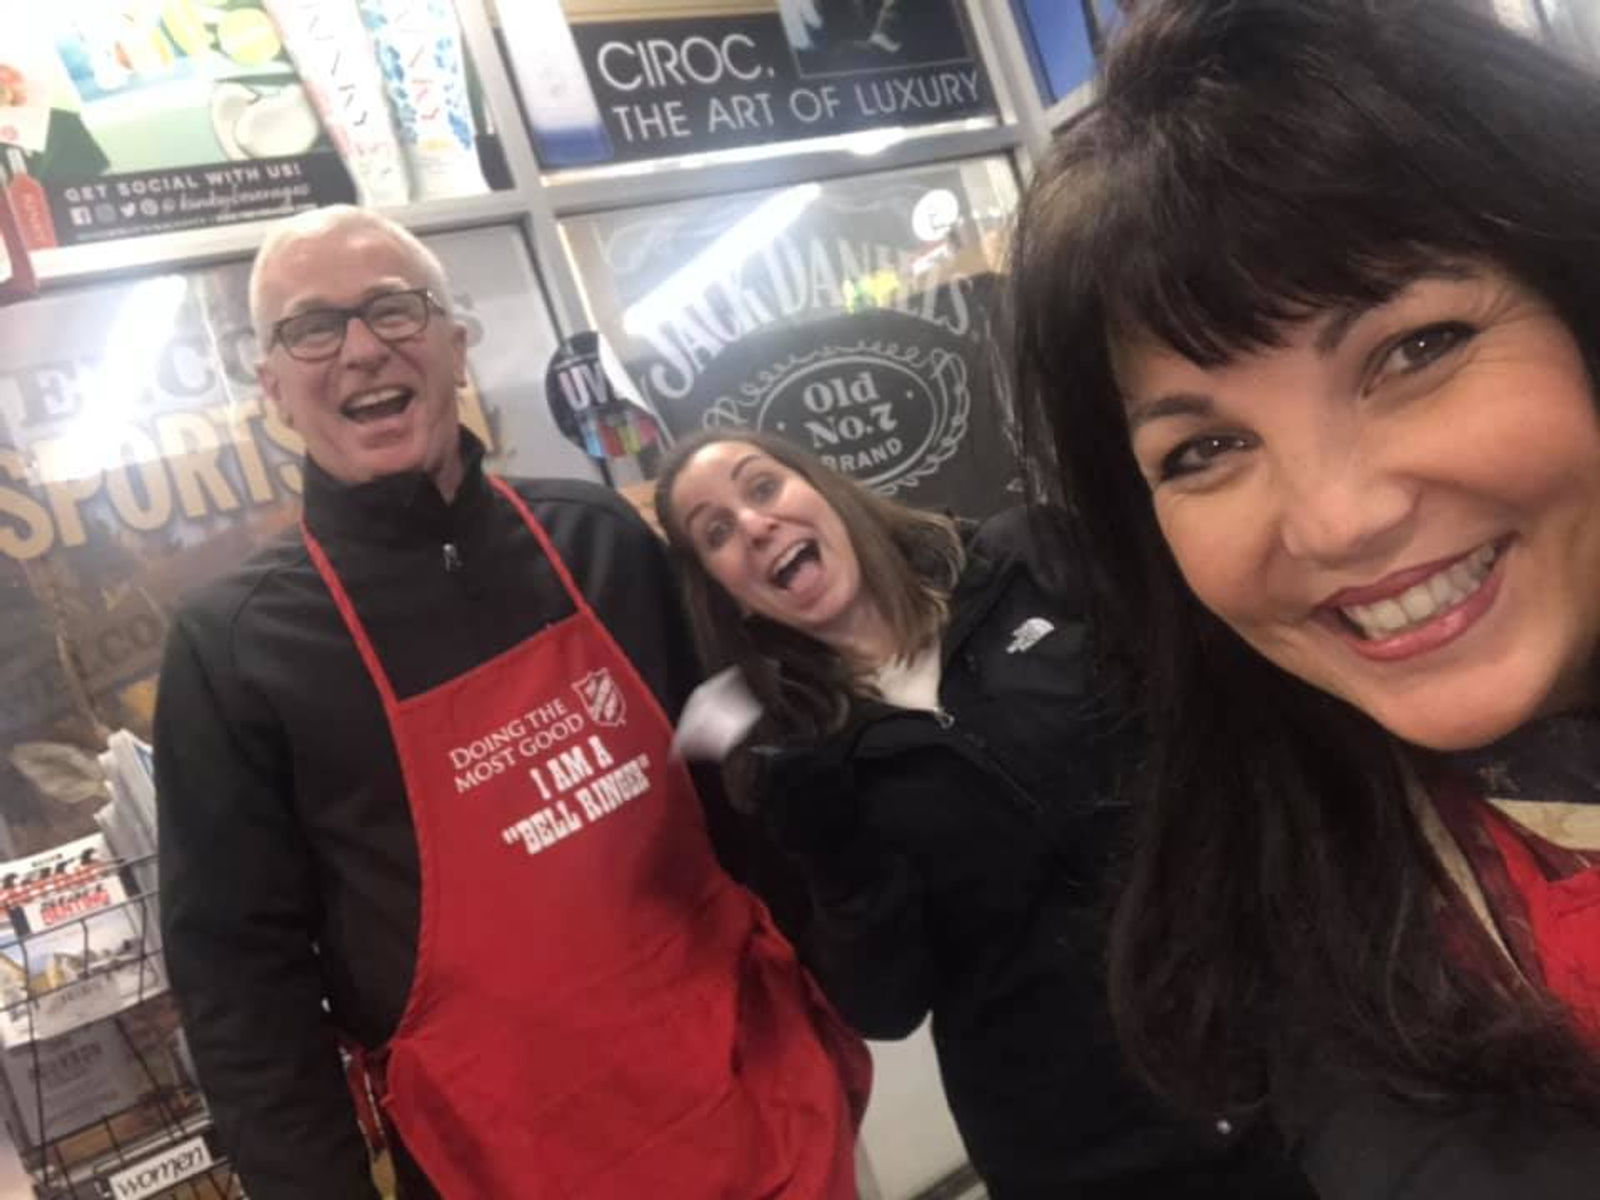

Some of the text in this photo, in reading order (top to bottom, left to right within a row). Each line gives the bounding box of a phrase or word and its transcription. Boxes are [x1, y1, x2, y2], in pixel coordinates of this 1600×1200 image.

[613, 70, 979, 143] THE ART OF LUXURY
[64, 162, 303, 201] GET SOCIAL WITH US!
[650, 251, 777, 399] JACK
[803, 371, 880, 414] Old
[820, 437, 903, 473] BRAND
[449, 697, 569, 771] DOING THE
[453, 712, 585, 794] MOST GOOD
[529, 734, 614, 801] I AM A
[116, 1146, 205, 1198] women
